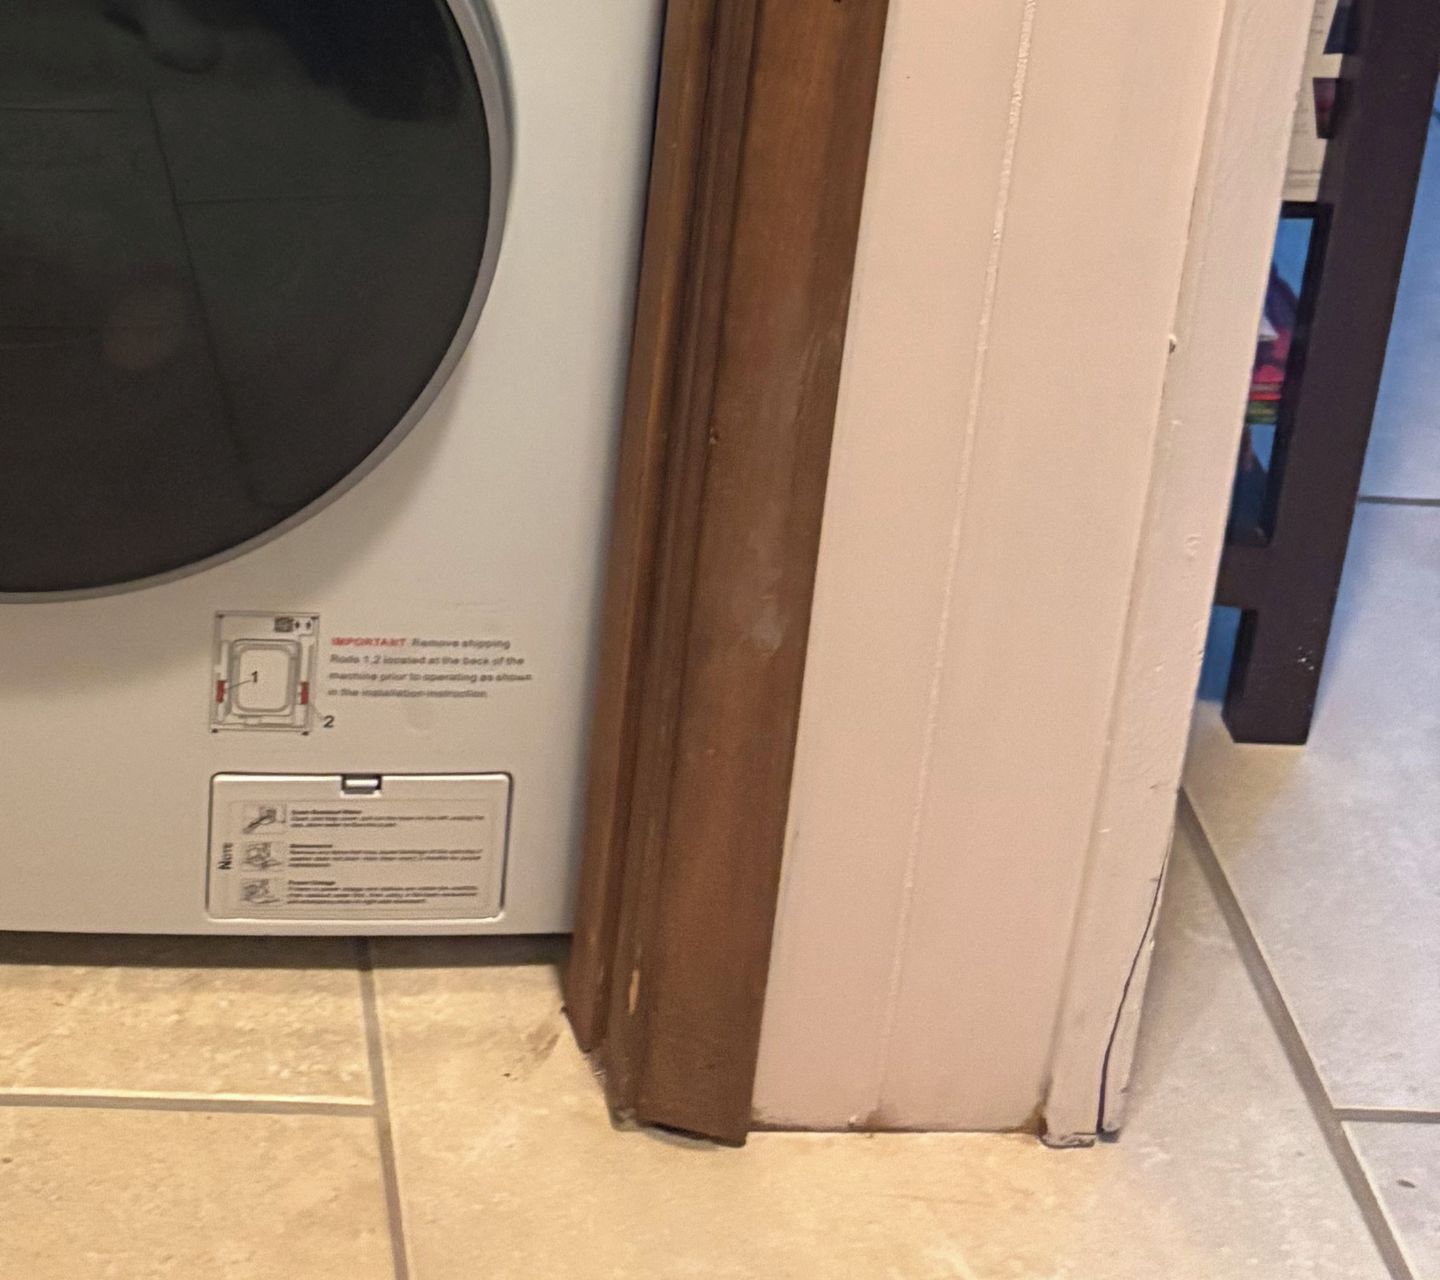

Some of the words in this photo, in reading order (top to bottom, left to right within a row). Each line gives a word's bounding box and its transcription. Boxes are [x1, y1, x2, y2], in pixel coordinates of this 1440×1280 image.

[411, 638, 459, 647] Remove
[462, 638, 511, 649] shipping
[383, 656, 426, 664] located
[506, 656, 525, 665] the
[251, 670, 258, 683] 1
[380, 673, 407, 682] prior
[410, 673, 421, 681] to
[422, 673, 477, 683] operating
[323, 715, 335, 728] 2
